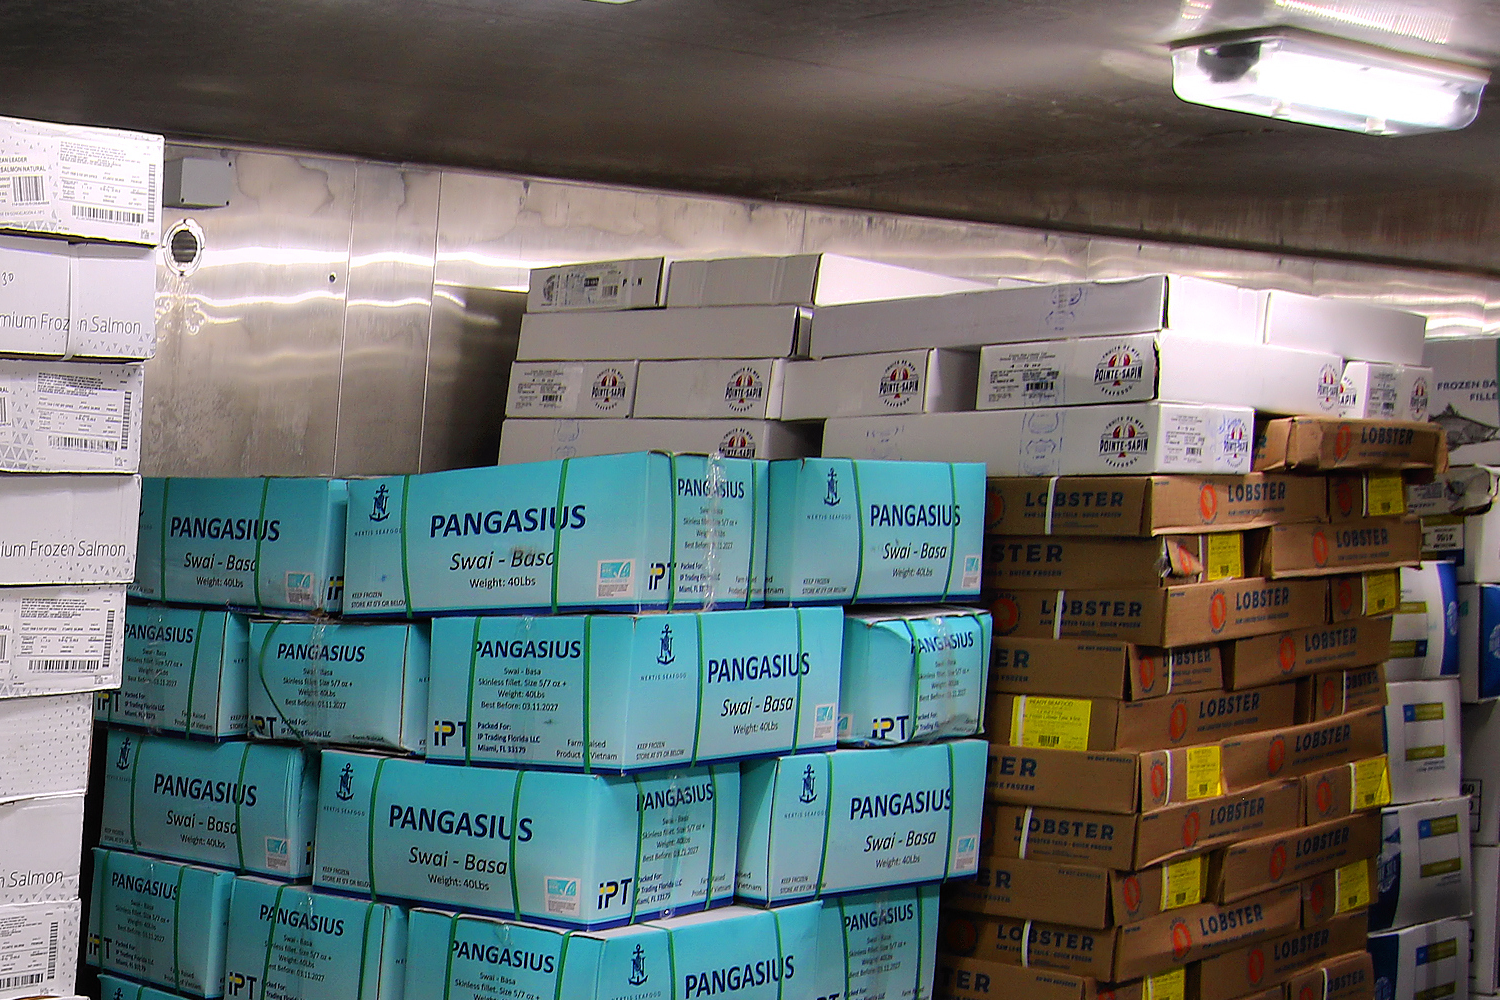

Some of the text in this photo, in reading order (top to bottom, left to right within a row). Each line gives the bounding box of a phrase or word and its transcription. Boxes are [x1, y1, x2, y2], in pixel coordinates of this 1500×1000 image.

[1361, 427, 1414, 445] LOBSTER
[1025, 492, 1124, 507] LOBSTER
[1228, 482, 1286, 503] LOBSTER
[430, 505, 586, 539] PANGASIUS
[870, 504, 961, 528] PANGASIUS
[170, 517, 280, 542] PANGASIUS
[1336, 529, 1389, 548] LOBSTER
[30, 541, 75, 558] Frozen
[77, 540, 126, 557] Salmon
[883, 542, 947, 561] Swai Basa
[184, 552, 215, 571] Swai
[450, 552, 494, 571] Swai
[469, 576, 535, 591] Weight: 40Lbs
[1235, 587, 1289, 610] LOBSTER
[1305, 627, 1358, 653] LOBSTER
[278, 643, 366, 664] PANGASIUS
[708, 653, 810, 683] PANGASIUS
[498, 690, 524, 698] Weight:
[524, 679, 537, 687] Size
[539, 680, 551, 688] 5/7
[481, 701, 495, 709] Best
[497, 701, 521, 710] Before:
[721, 696, 793, 718] Swai Basa
[1199, 692, 1260, 718] LOBSTER
[1295, 724, 1351, 753] LOBSTER
[153, 773, 257, 807] PANGASIUS
[849, 787, 952, 821] PANGASIUS
[1210, 798, 1265, 827] LOBSTER
[390, 804, 533, 842] PANGASIUS
[409, 846, 508, 876] Swai Basa
[259, 904, 344, 936] PANGASIUS
[1200, 904, 1263, 937] LOBSTER
[452, 939, 555, 974] PANGASIUS
[685, 956, 795, 1000] PANGASIUS
